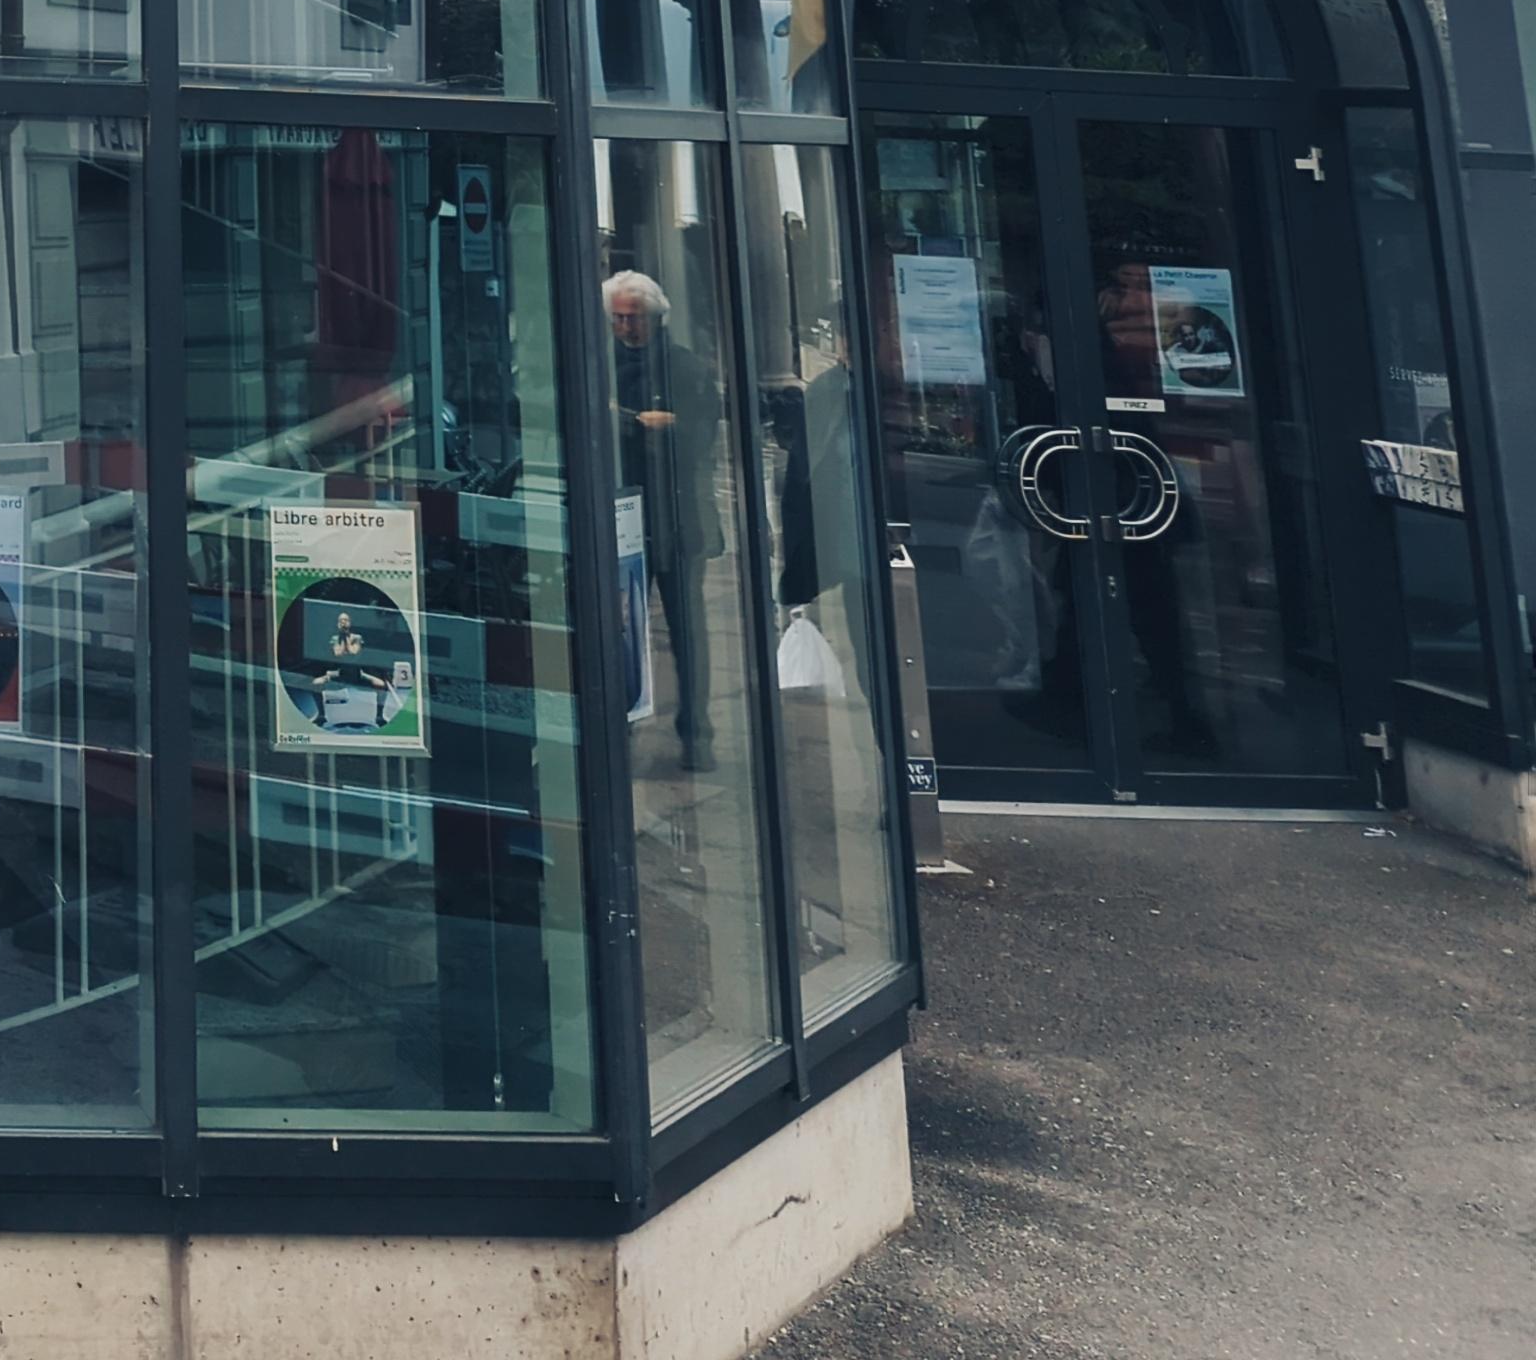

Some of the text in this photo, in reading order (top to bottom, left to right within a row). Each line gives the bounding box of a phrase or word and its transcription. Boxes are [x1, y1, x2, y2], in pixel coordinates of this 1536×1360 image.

[273, 510, 385, 528] Libre arbitre
[400, 670, 409, 681] 3
[907, 763, 924, 774] ve
[908, 774, 933, 789] vey
